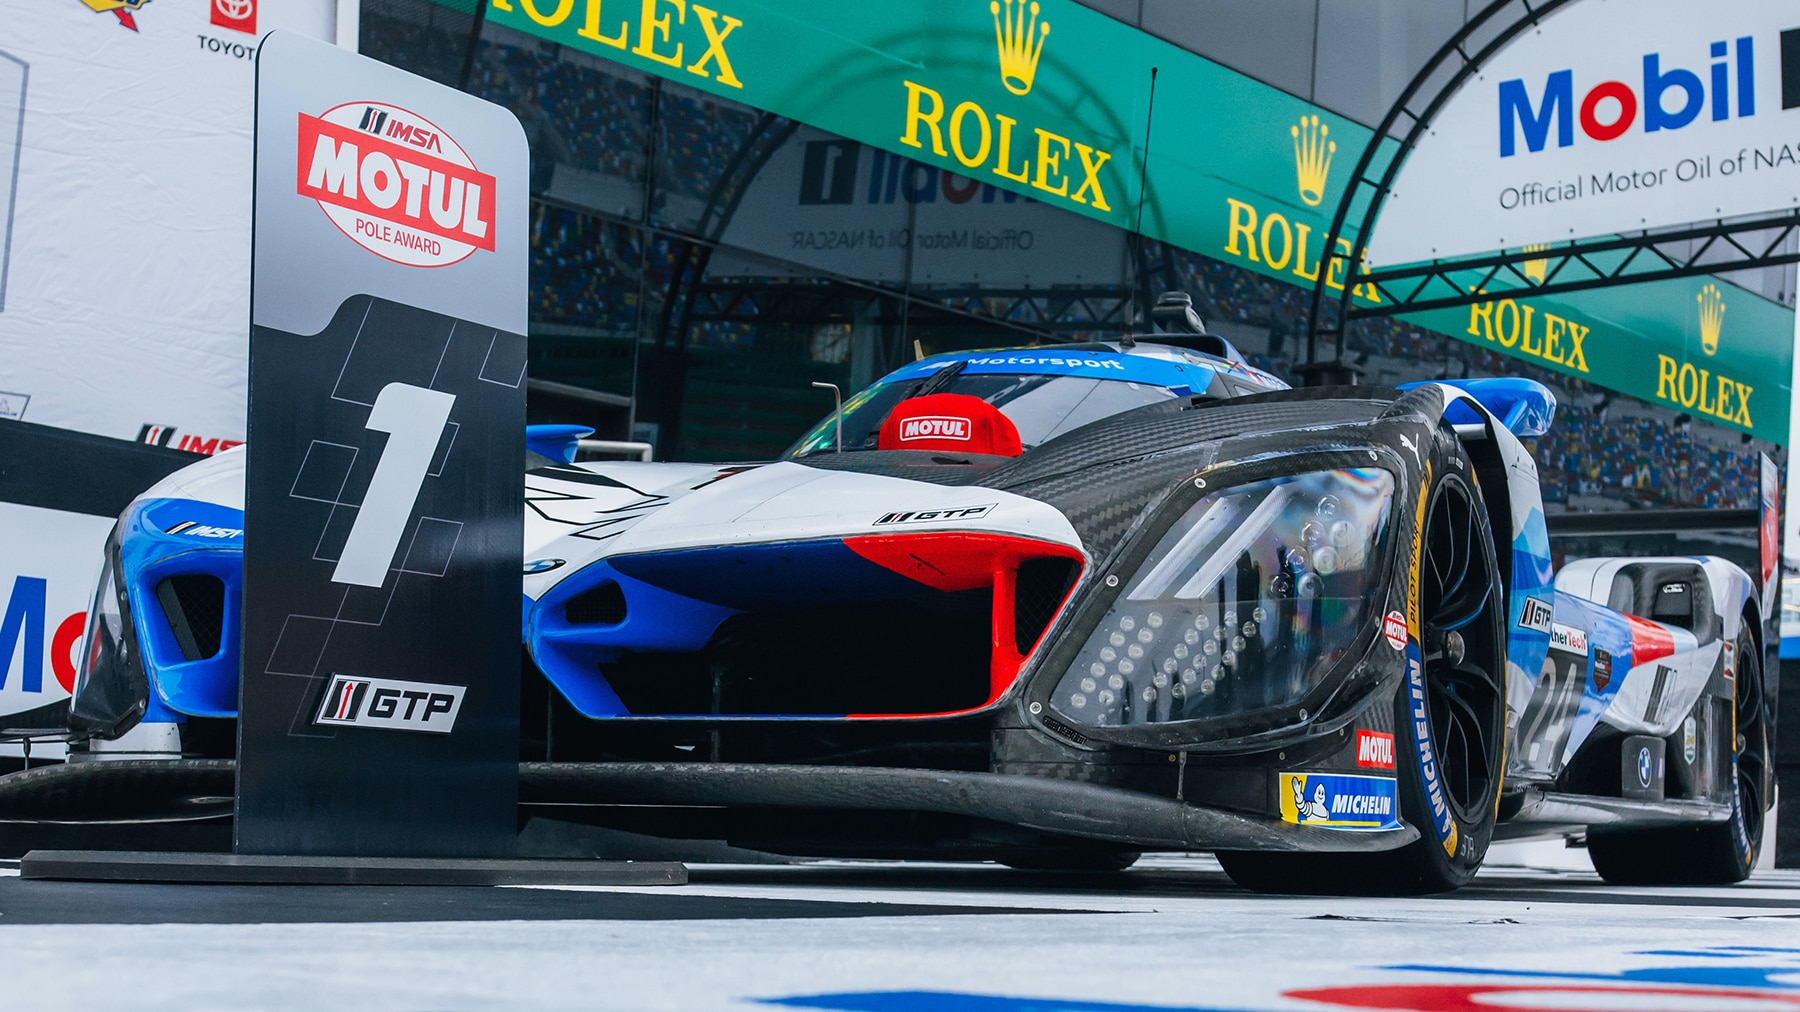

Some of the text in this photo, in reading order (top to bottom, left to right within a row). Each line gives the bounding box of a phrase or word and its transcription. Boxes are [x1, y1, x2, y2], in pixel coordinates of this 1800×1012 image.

[198, 35, 255, 61] TOYOT
[492, 0, 743, 88] LEX
[1499, 36, 1755, 158] Mobil
[386, 119, 442, 154] IMSA
[900, 80, 1111, 212] ROLEX
[307, 133, 488, 239] MOTUL
[1499, 142, 1800, 210] Official Motor Oil of NA
[356, 218, 441, 256] POLE AWARD
[1467, 286, 1590, 373] ROLEX
[968, 357, 1125, 370] Motorsport
[1656, 354, 1753, 428] ROLEX
[905, 420, 965, 437] MOTUL
[331, 382, 456, 588] 1
[914, 507, 987, 520] GTP
[1386, 619, 1408, 642] MOTUL
[1534, 607, 1551, 629] GTP
[367, 688, 455, 722] GTP
[1359, 734, 1393, 764] MOTUL
[1410, 658, 1446, 818] MICHELIN
[1332, 794, 1391, 816] MICHELIN
